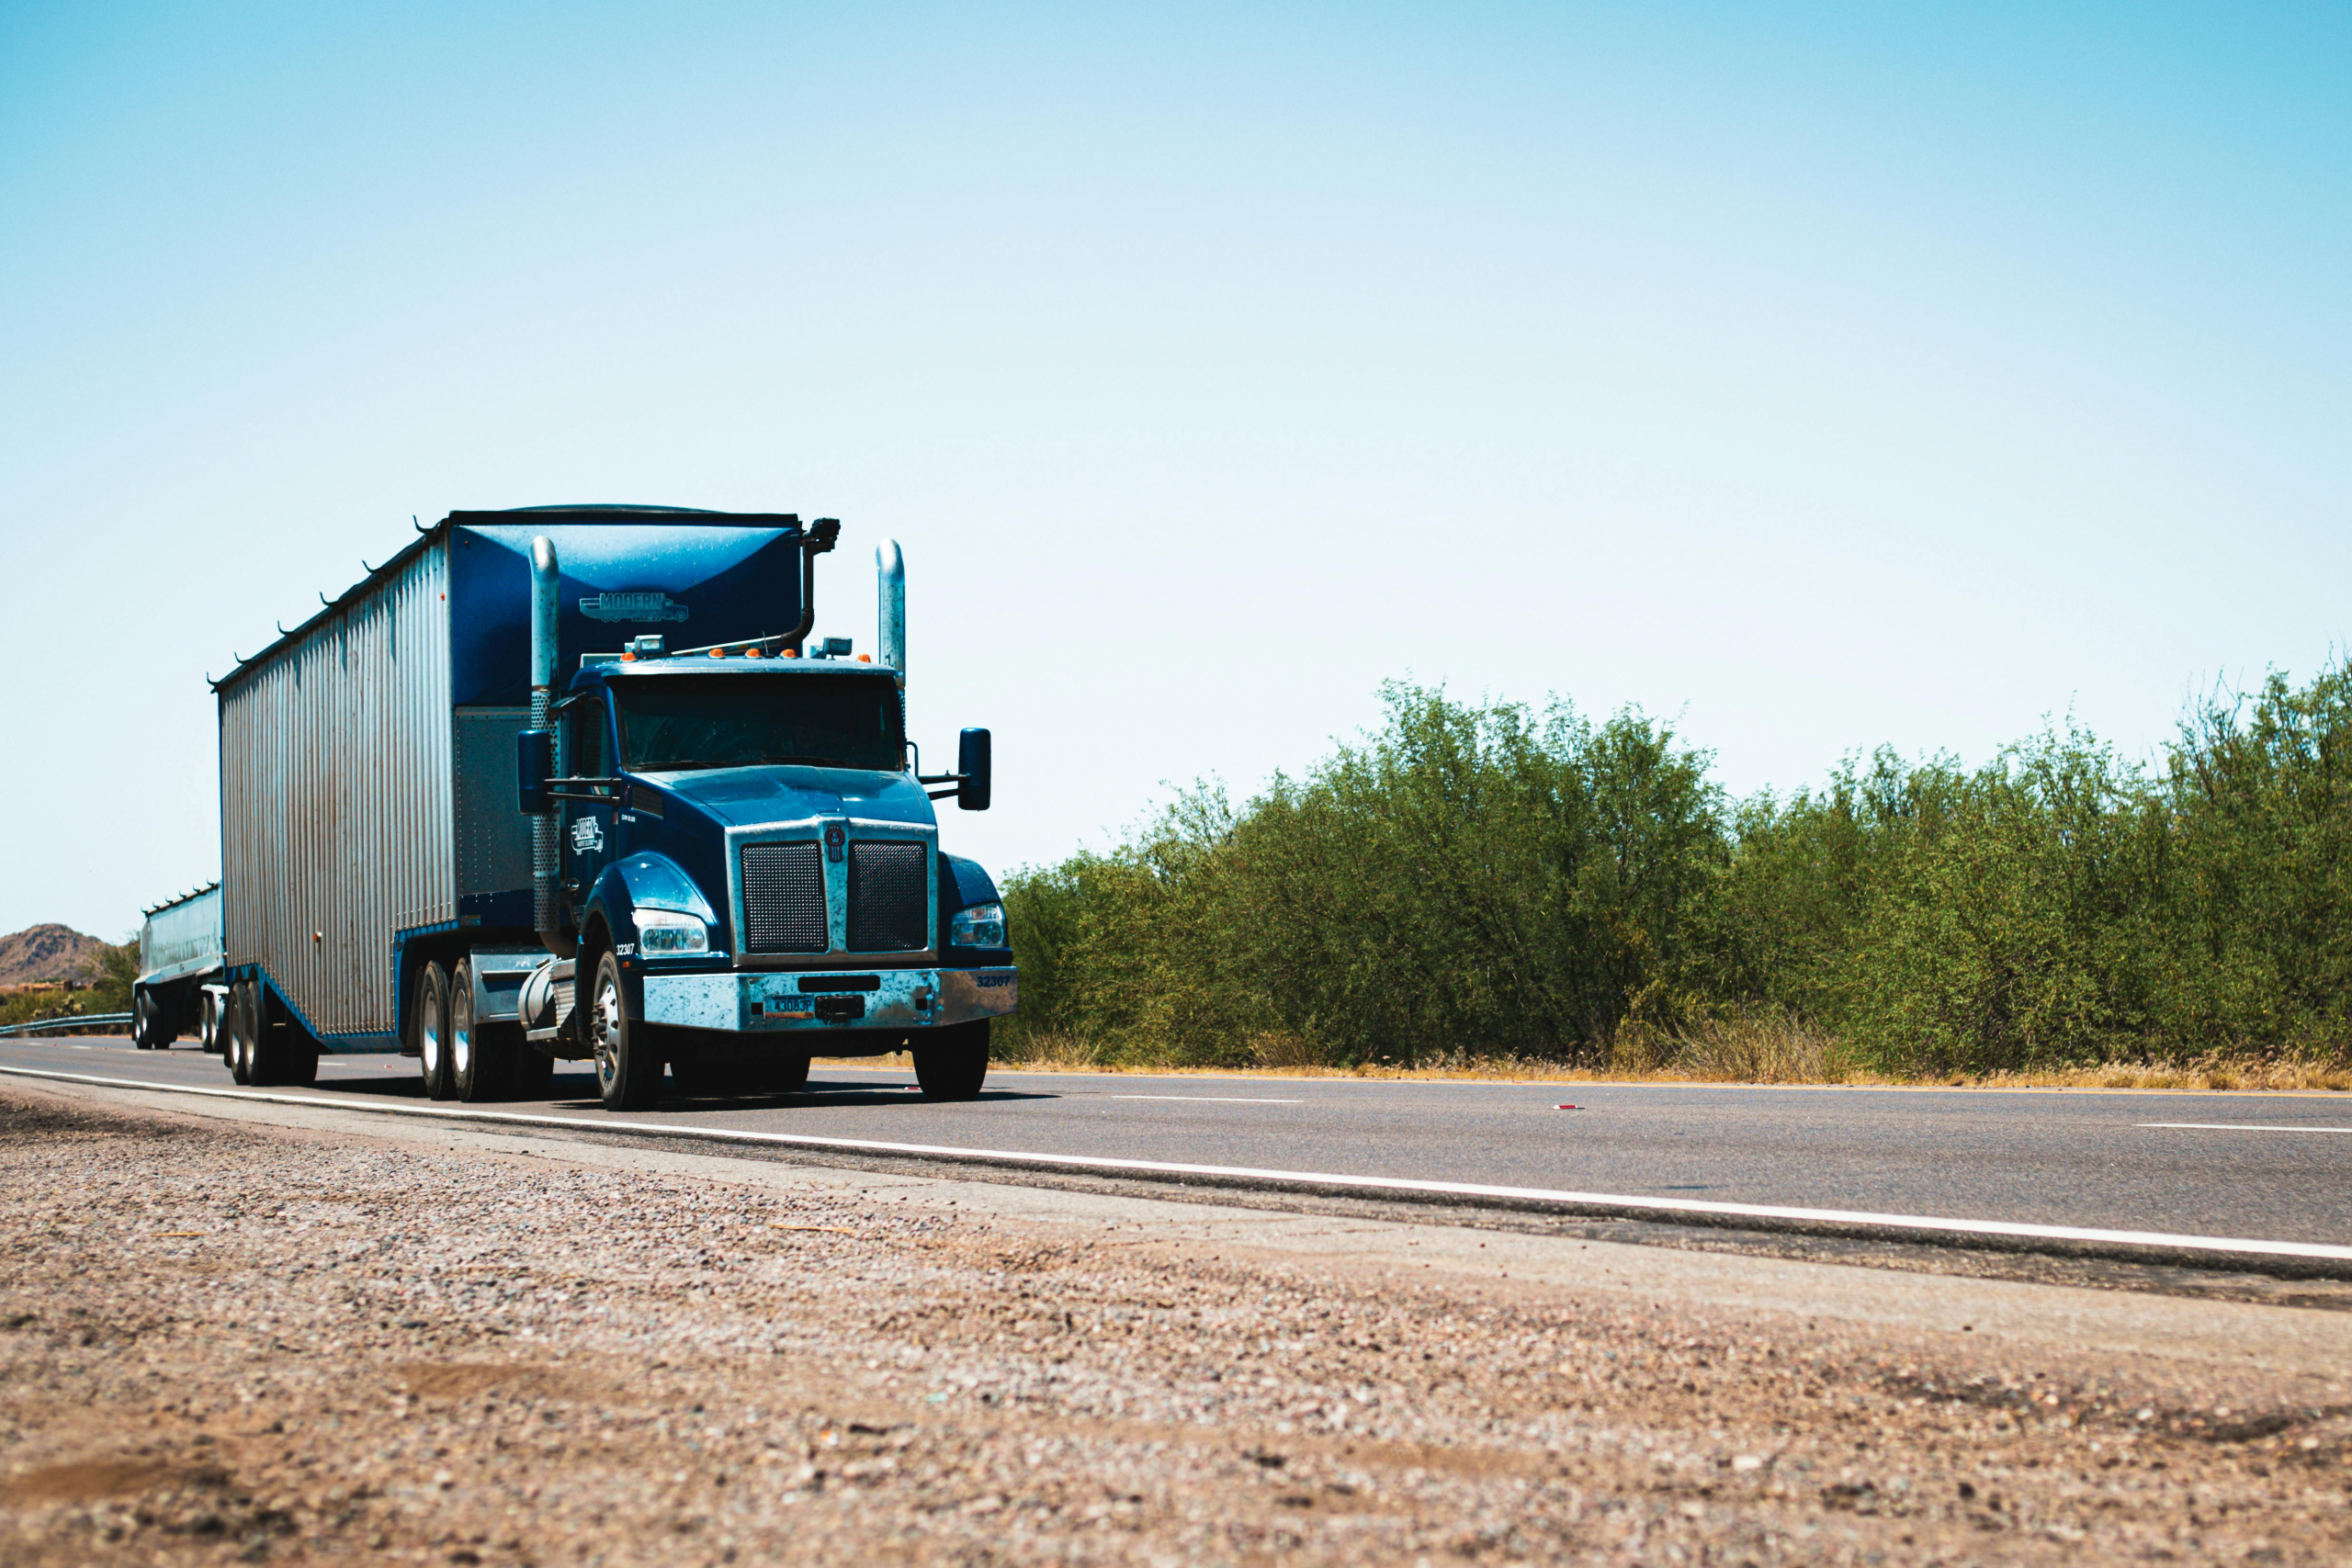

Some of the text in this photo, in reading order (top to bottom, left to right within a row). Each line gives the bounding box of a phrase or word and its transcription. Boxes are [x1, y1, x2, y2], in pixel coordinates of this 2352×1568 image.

[600, 592, 663, 610] MODERN
[576, 816, 596, 840] MODERN
[616, 942, 635, 956] 32307
[977, 976, 1011, 987] 32307
[775, 999, 812, 1012] 43083P
